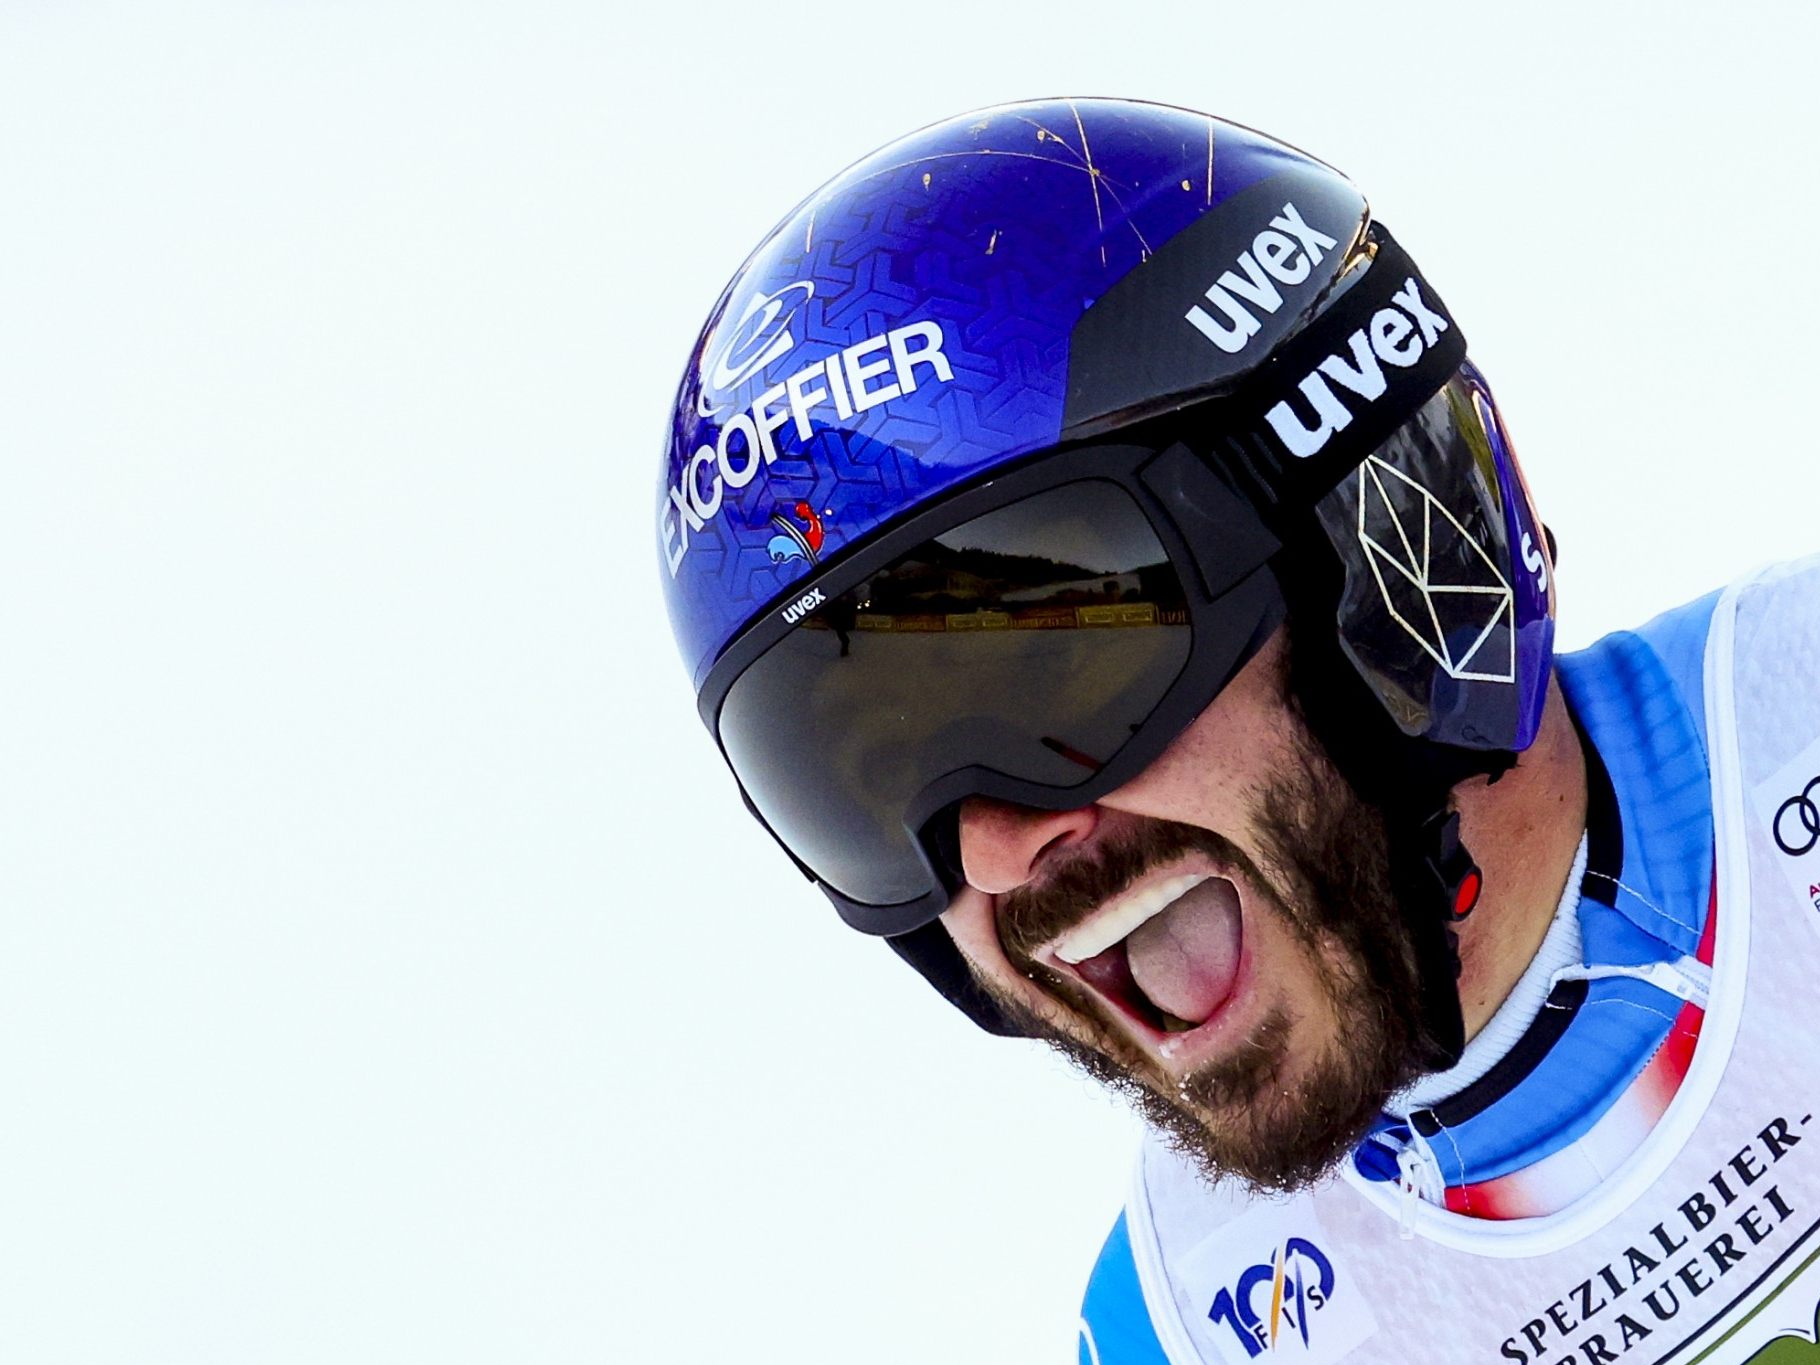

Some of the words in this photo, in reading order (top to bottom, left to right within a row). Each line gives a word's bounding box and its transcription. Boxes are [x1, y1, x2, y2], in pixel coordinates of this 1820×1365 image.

[1184, 201, 1339, 354] uvex
[660, 320, 954, 580] EXCOFFIER
[1263, 276, 1449, 459] uvex
[782, 586, 826, 624] uvex
